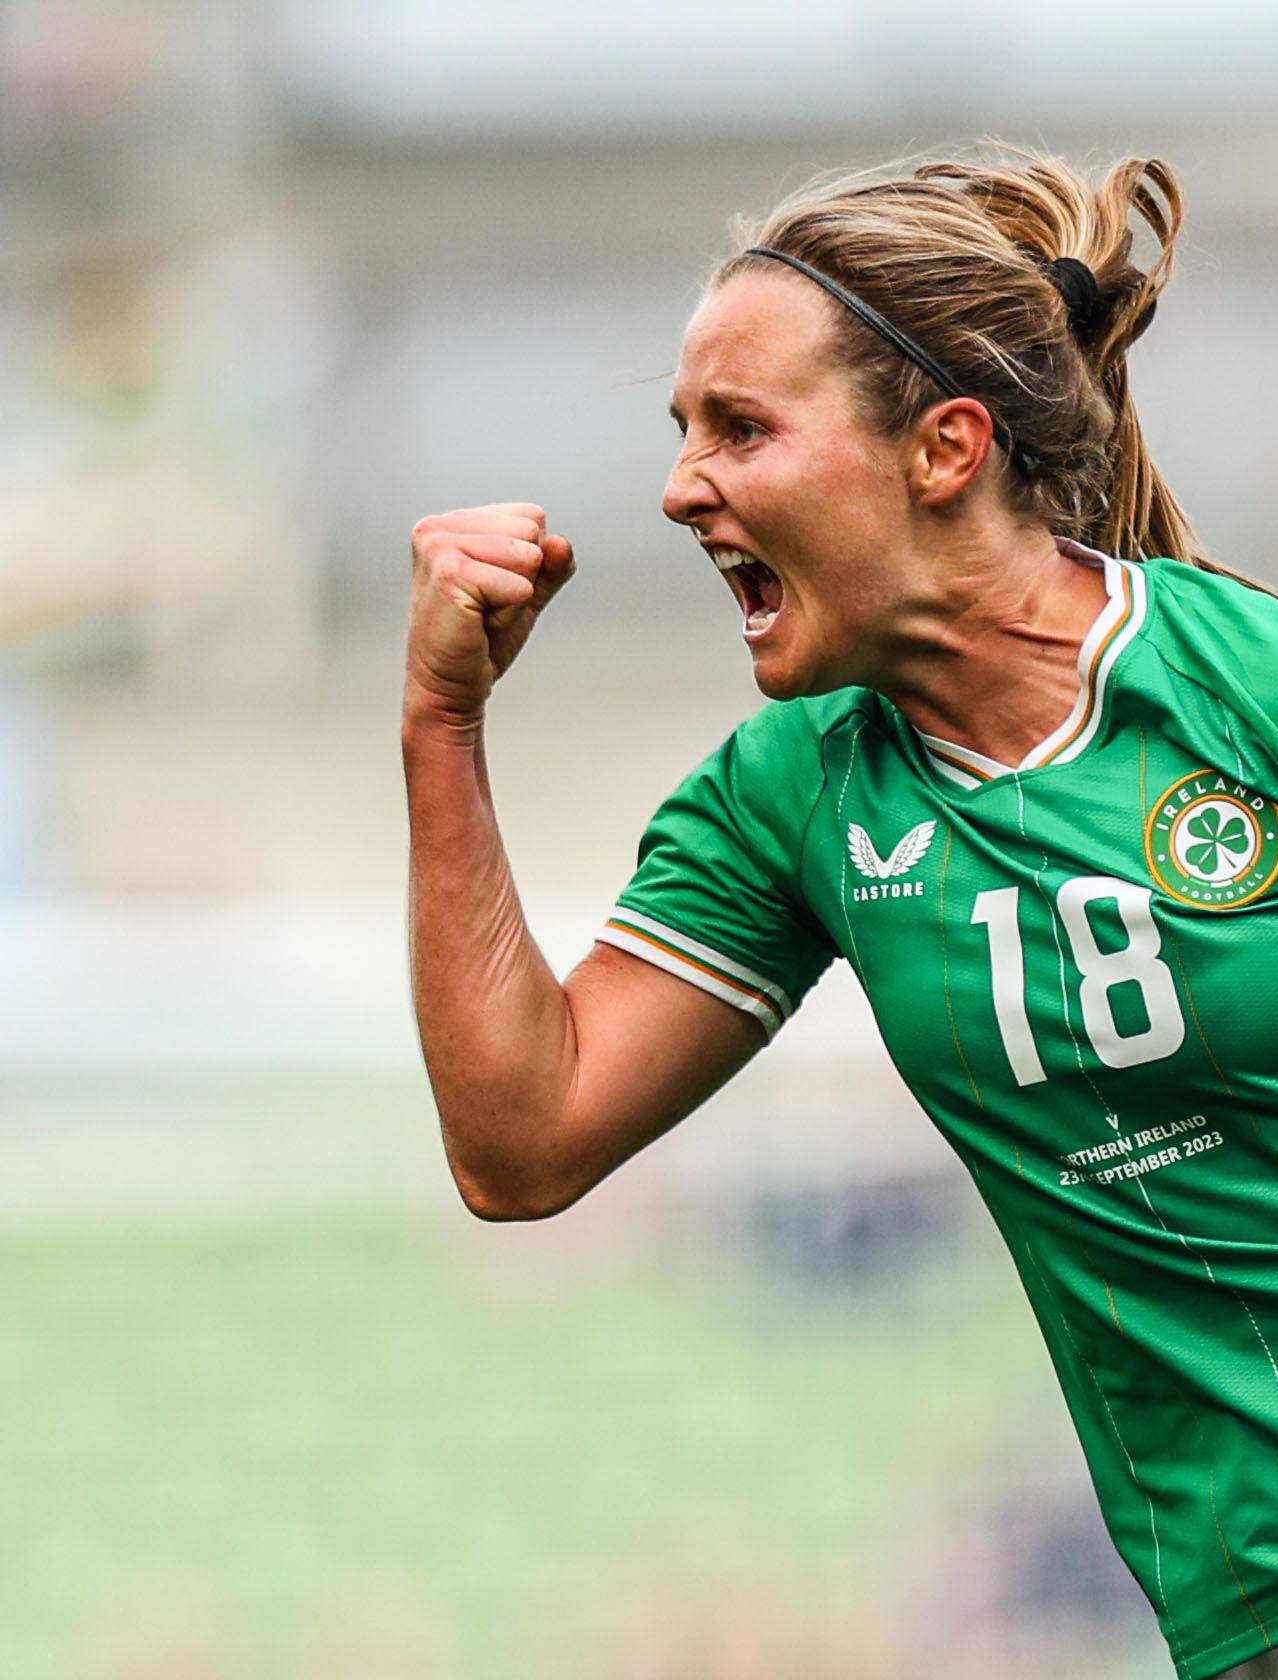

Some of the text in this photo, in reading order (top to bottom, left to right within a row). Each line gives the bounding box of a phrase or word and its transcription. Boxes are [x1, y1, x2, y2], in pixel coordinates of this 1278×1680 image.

[1156, 777, 1265, 831] IRELAND
[853, 881, 924, 902] CASTORE
[1181, 872, 1264, 901] FOOTBALL
[970, 875, 1186, 1087] 18
[1060, 1114, 1208, 1168] RTHERN IRELAND
[1182, 1131, 1224, 1158] 2023
